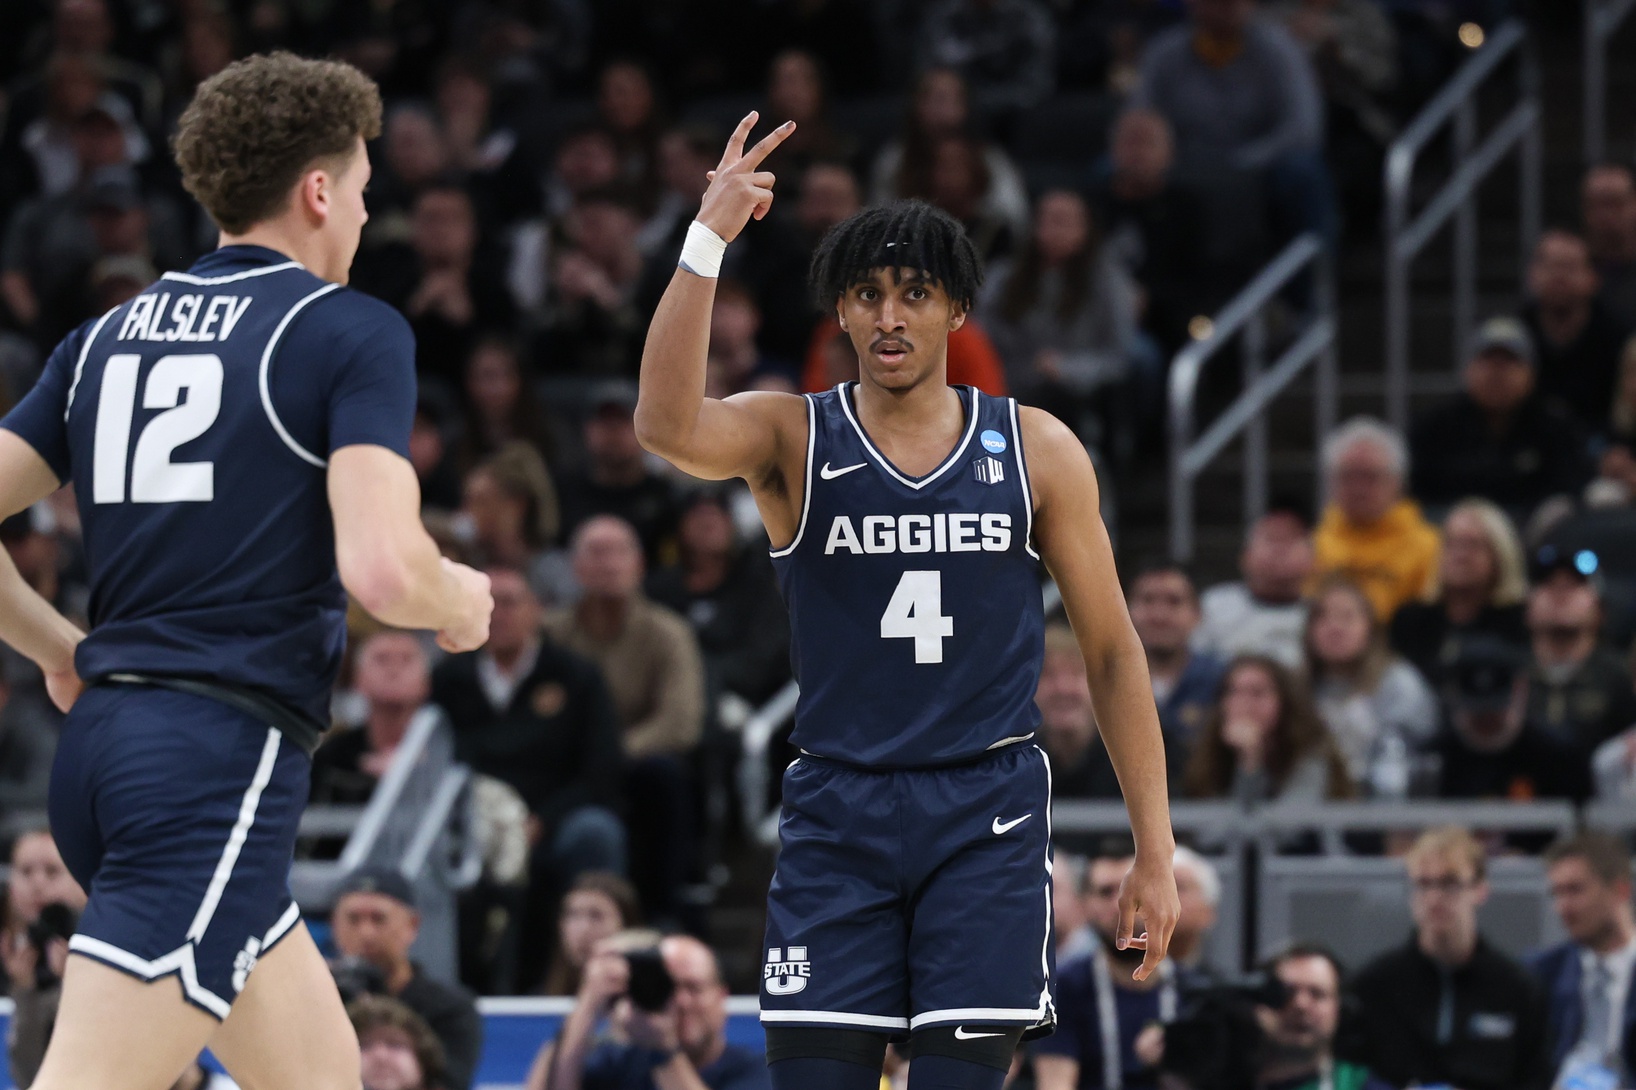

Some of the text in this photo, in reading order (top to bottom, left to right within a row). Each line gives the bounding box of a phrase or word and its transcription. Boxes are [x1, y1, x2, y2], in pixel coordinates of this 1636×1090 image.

[117, 292, 253, 342] FALSLEV
[93, 353, 224, 504] 12
[984, 439, 1006, 449] NCAA
[824, 513, 1012, 555] AGGIES
[880, 570, 954, 664] 4
[764, 961, 811, 979] STATE
